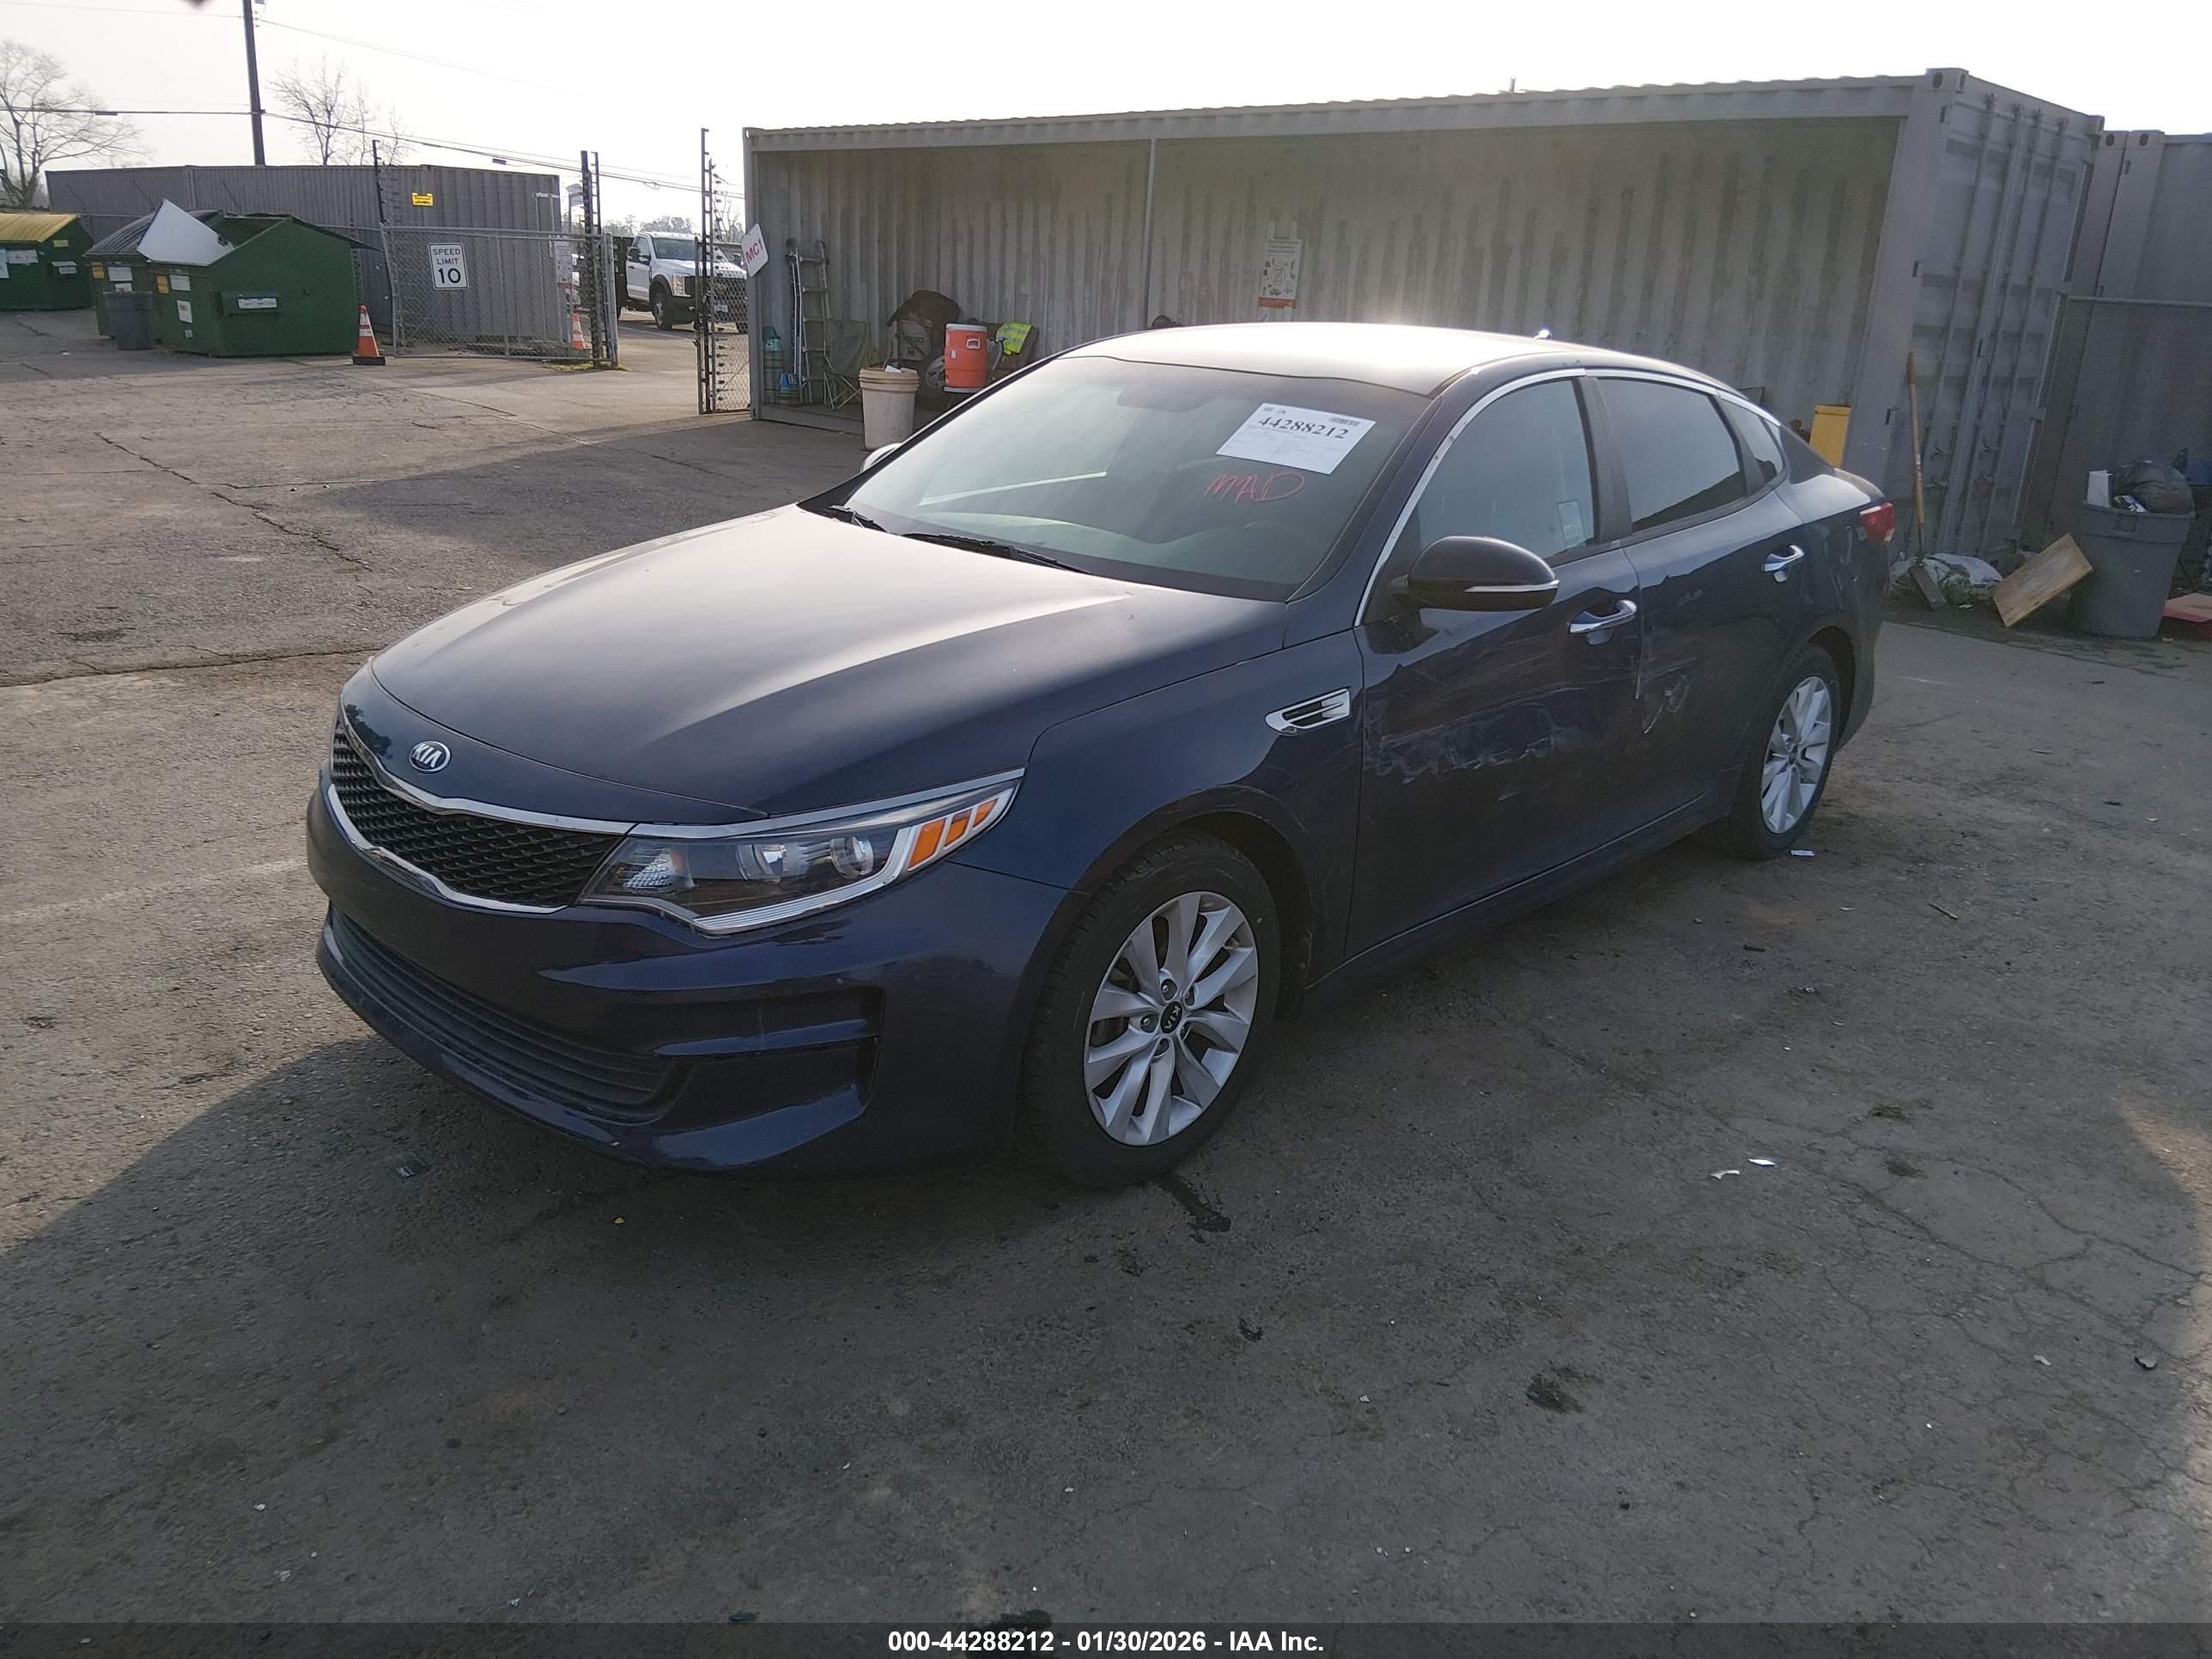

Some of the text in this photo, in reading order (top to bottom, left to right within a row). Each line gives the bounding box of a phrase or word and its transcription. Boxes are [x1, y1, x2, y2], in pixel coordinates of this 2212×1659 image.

[745, 237, 763, 264] MC1
[437, 268, 461, 283] 10
[1258, 416, 1350, 440] 44288212
[411, 744, 442, 769] KIA
[1164, 1005, 1181, 1029] KIA
